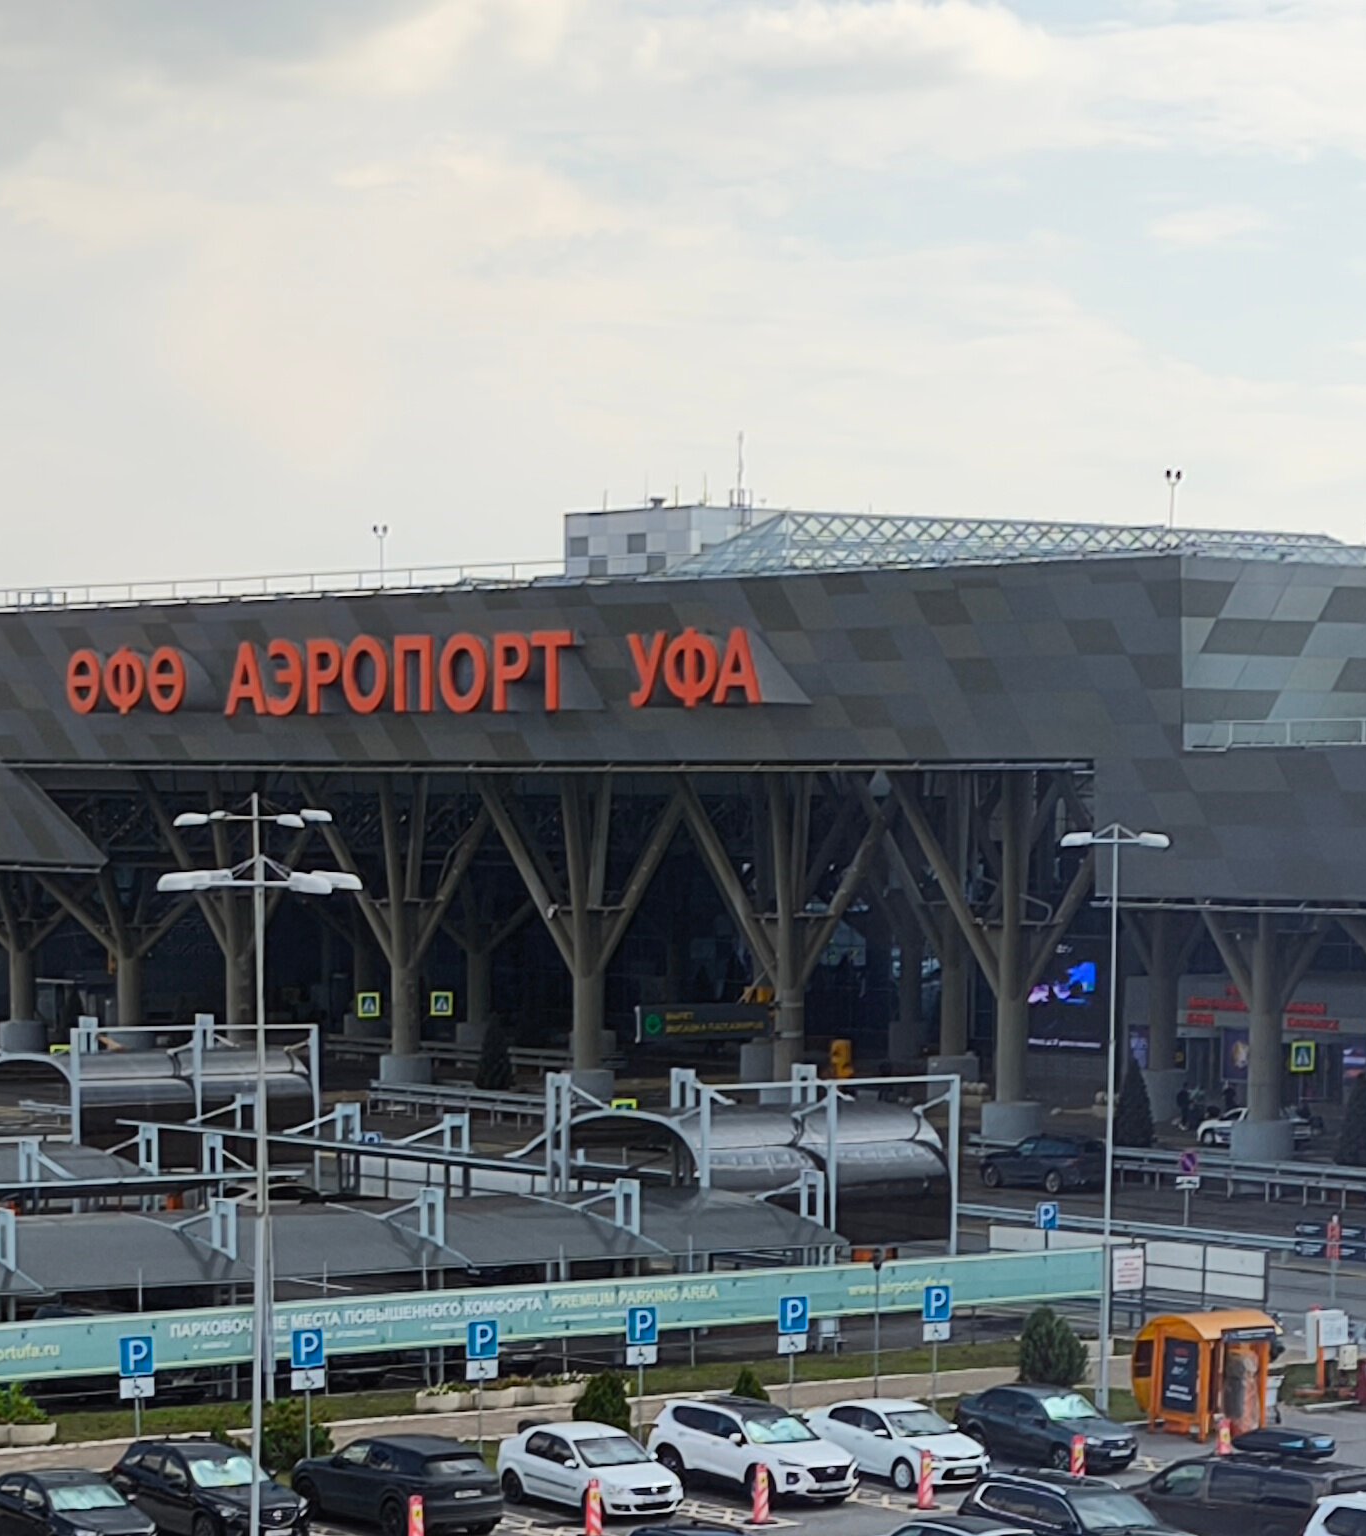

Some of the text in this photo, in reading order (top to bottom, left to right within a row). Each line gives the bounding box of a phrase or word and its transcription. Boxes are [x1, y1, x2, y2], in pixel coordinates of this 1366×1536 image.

[224, 629, 573, 717] АЭРОПОРТ
[627, 626, 762, 709] УФА
[170, 1314, 287, 1339] ПАРКОВОЧЕ
[290, 1310, 341, 1329] МЕСТА
[344, 1301, 462, 1326] ПОВЫШЕННОГО
[463, 1296, 543, 1317] КОМФОРТА
[551, 1283, 719, 1310] PREMIUM PARKING AREA
